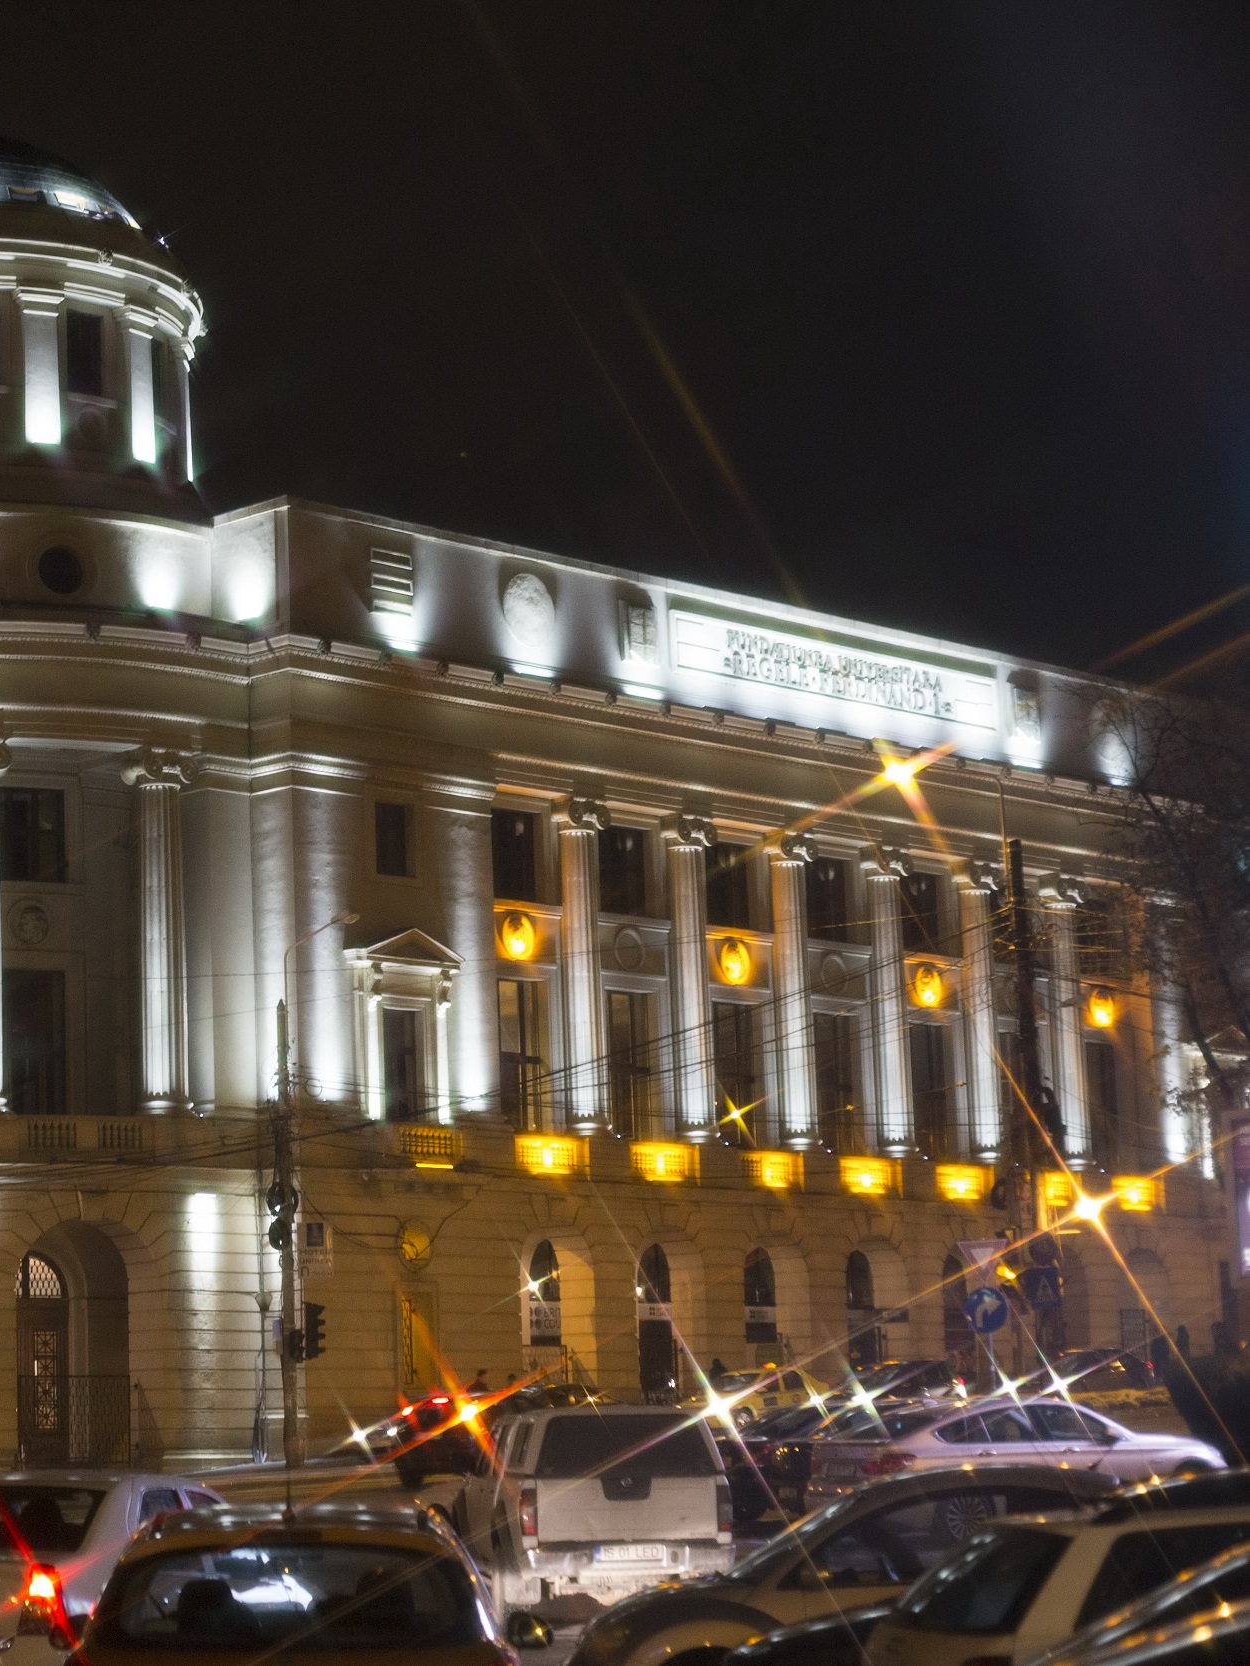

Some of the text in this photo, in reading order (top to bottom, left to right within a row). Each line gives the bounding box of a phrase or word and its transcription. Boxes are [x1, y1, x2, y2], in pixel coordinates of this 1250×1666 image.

[733, 651, 809, 687] REGELE
[818, 669, 926, 711] FERDINAND
[618, 1547, 630, 1558] 01
[636, 1546, 659, 1558] LED
